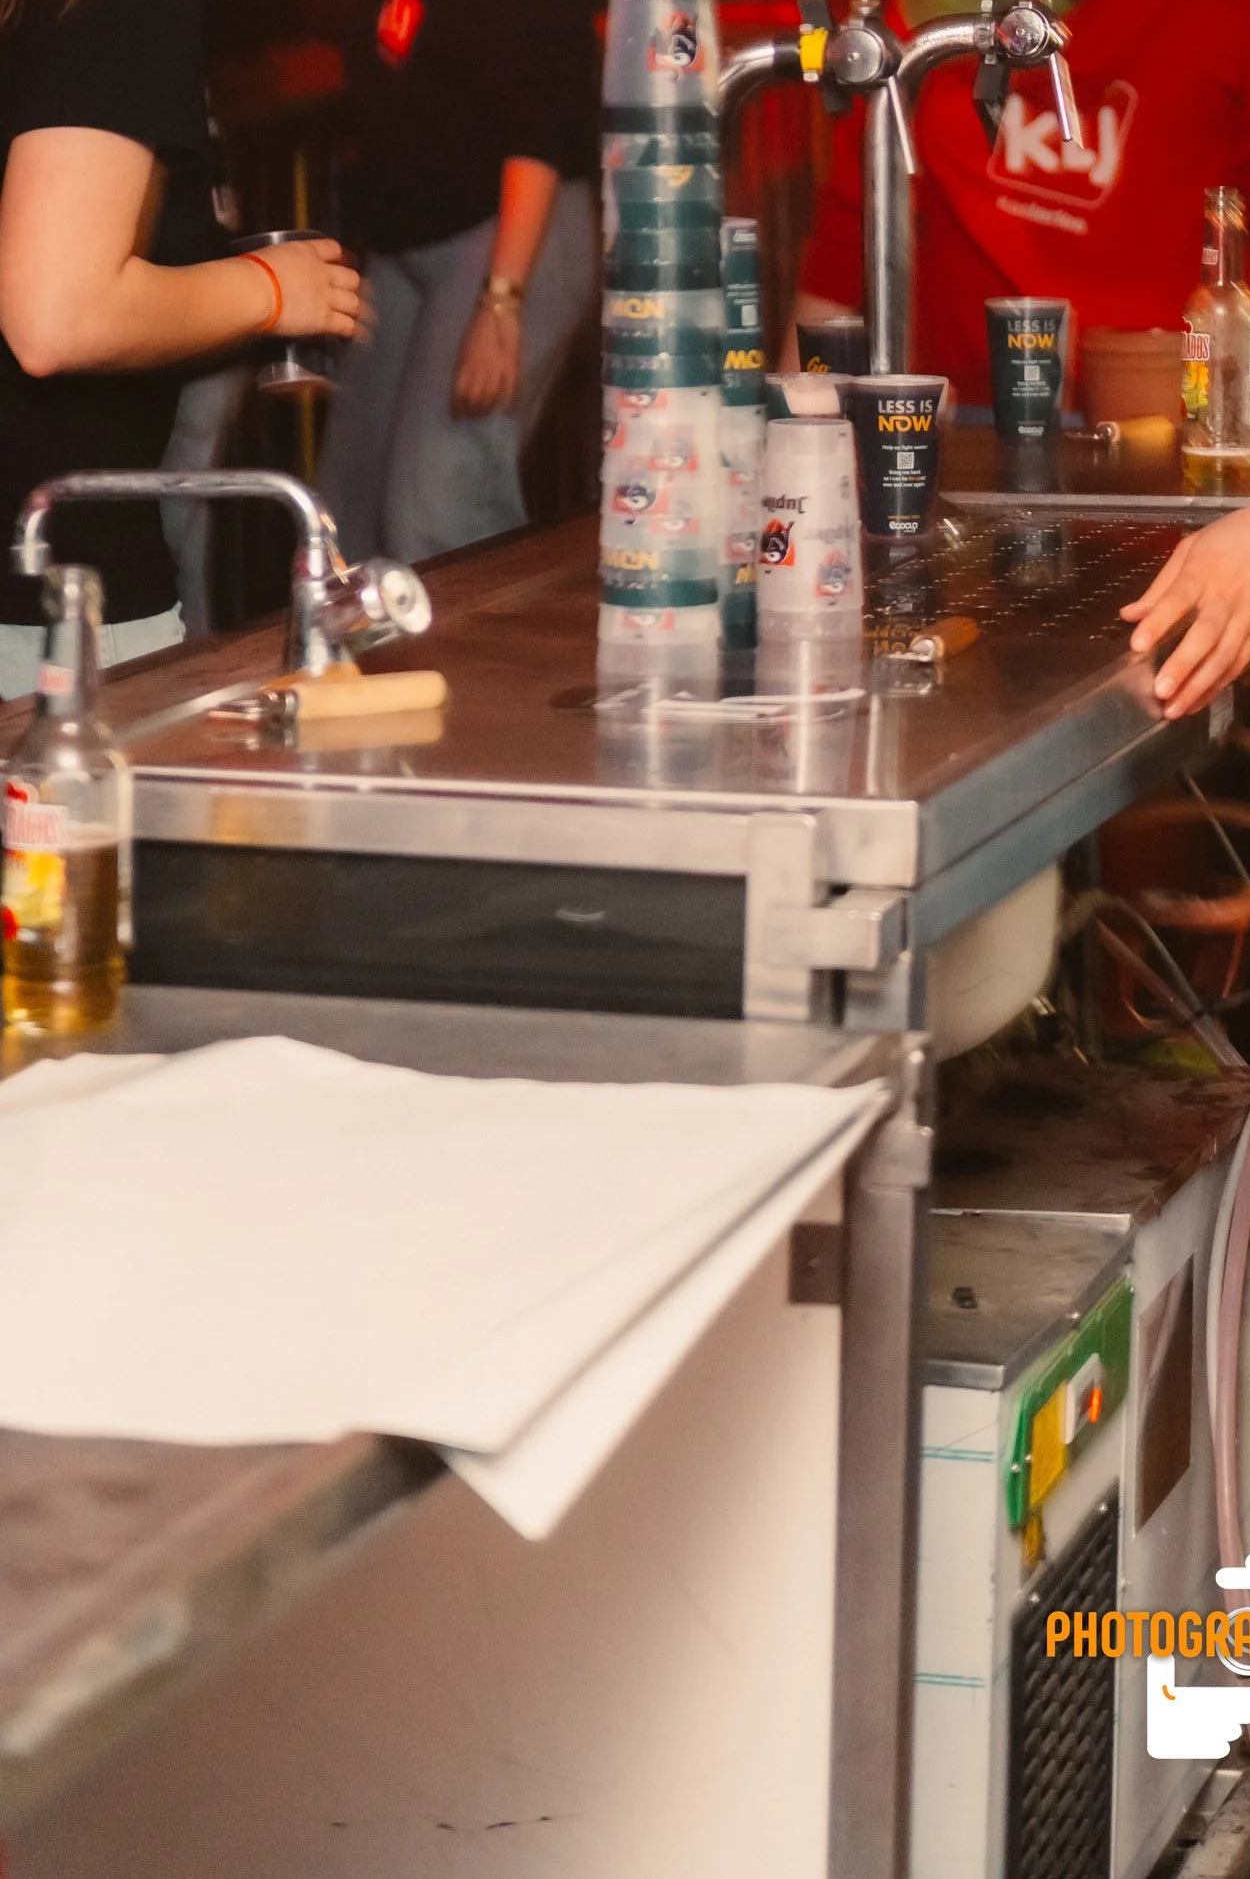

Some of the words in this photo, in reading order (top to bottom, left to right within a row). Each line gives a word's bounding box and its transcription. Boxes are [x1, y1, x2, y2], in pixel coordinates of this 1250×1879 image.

[1007, 320, 1040, 333] LESS
[1007, 333, 1055, 349] NOW
[878, 399, 916, 414] LESS
[920, 399, 933, 414] IS
[878, 414, 933, 433] NOW
